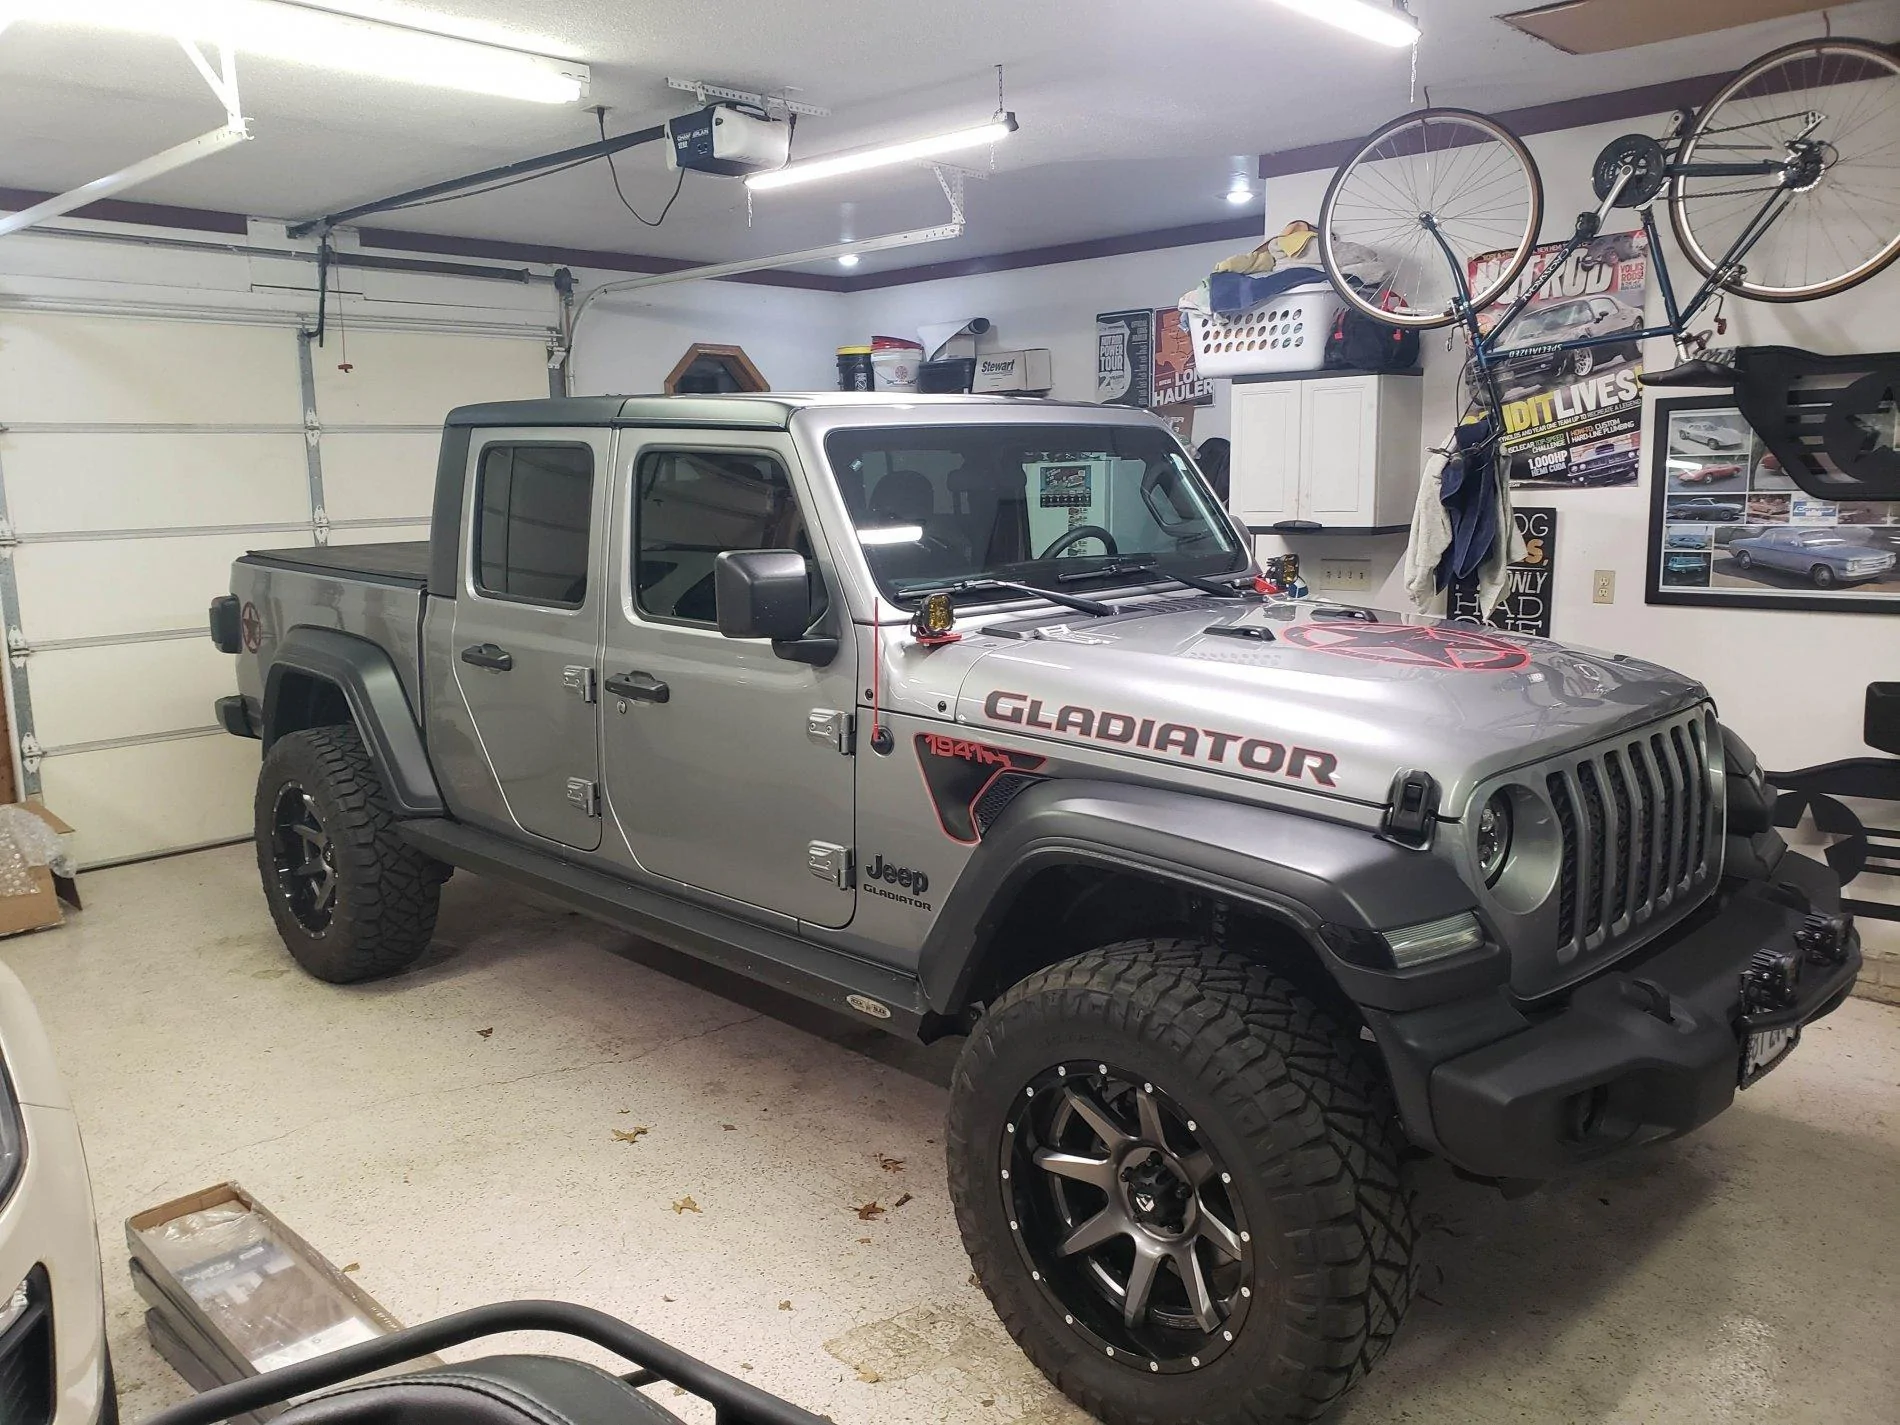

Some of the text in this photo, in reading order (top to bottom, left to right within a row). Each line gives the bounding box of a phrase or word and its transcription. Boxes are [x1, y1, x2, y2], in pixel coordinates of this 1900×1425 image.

[1100, 344, 1123, 356] POWER
[1509, 343, 1563, 358] SPECIALIZED
[981, 359, 1015, 373] Stewart
[1100, 355, 1123, 371] TOUR
[1174, 368, 1204, 387] LON
[1152, 378, 1214, 407] HAULER
[1533, 425, 1547, 435] YEAR
[1557, 417, 1572, 429] TEAM
[1587, 406, 1614, 419] RECREATE
[1595, 418, 1620, 431] CUSTOM
[1571, 421, 1635, 443] HARD-LINE PLUMBING
[1532, 440, 1566, 454] CHALLENGE
[925, 734, 983, 763] 1941
[984, 690, 1338, 787] GLADIATOR
[865, 853, 929, 896] Jeep
[863, 883, 932, 911] GLADIATOR
